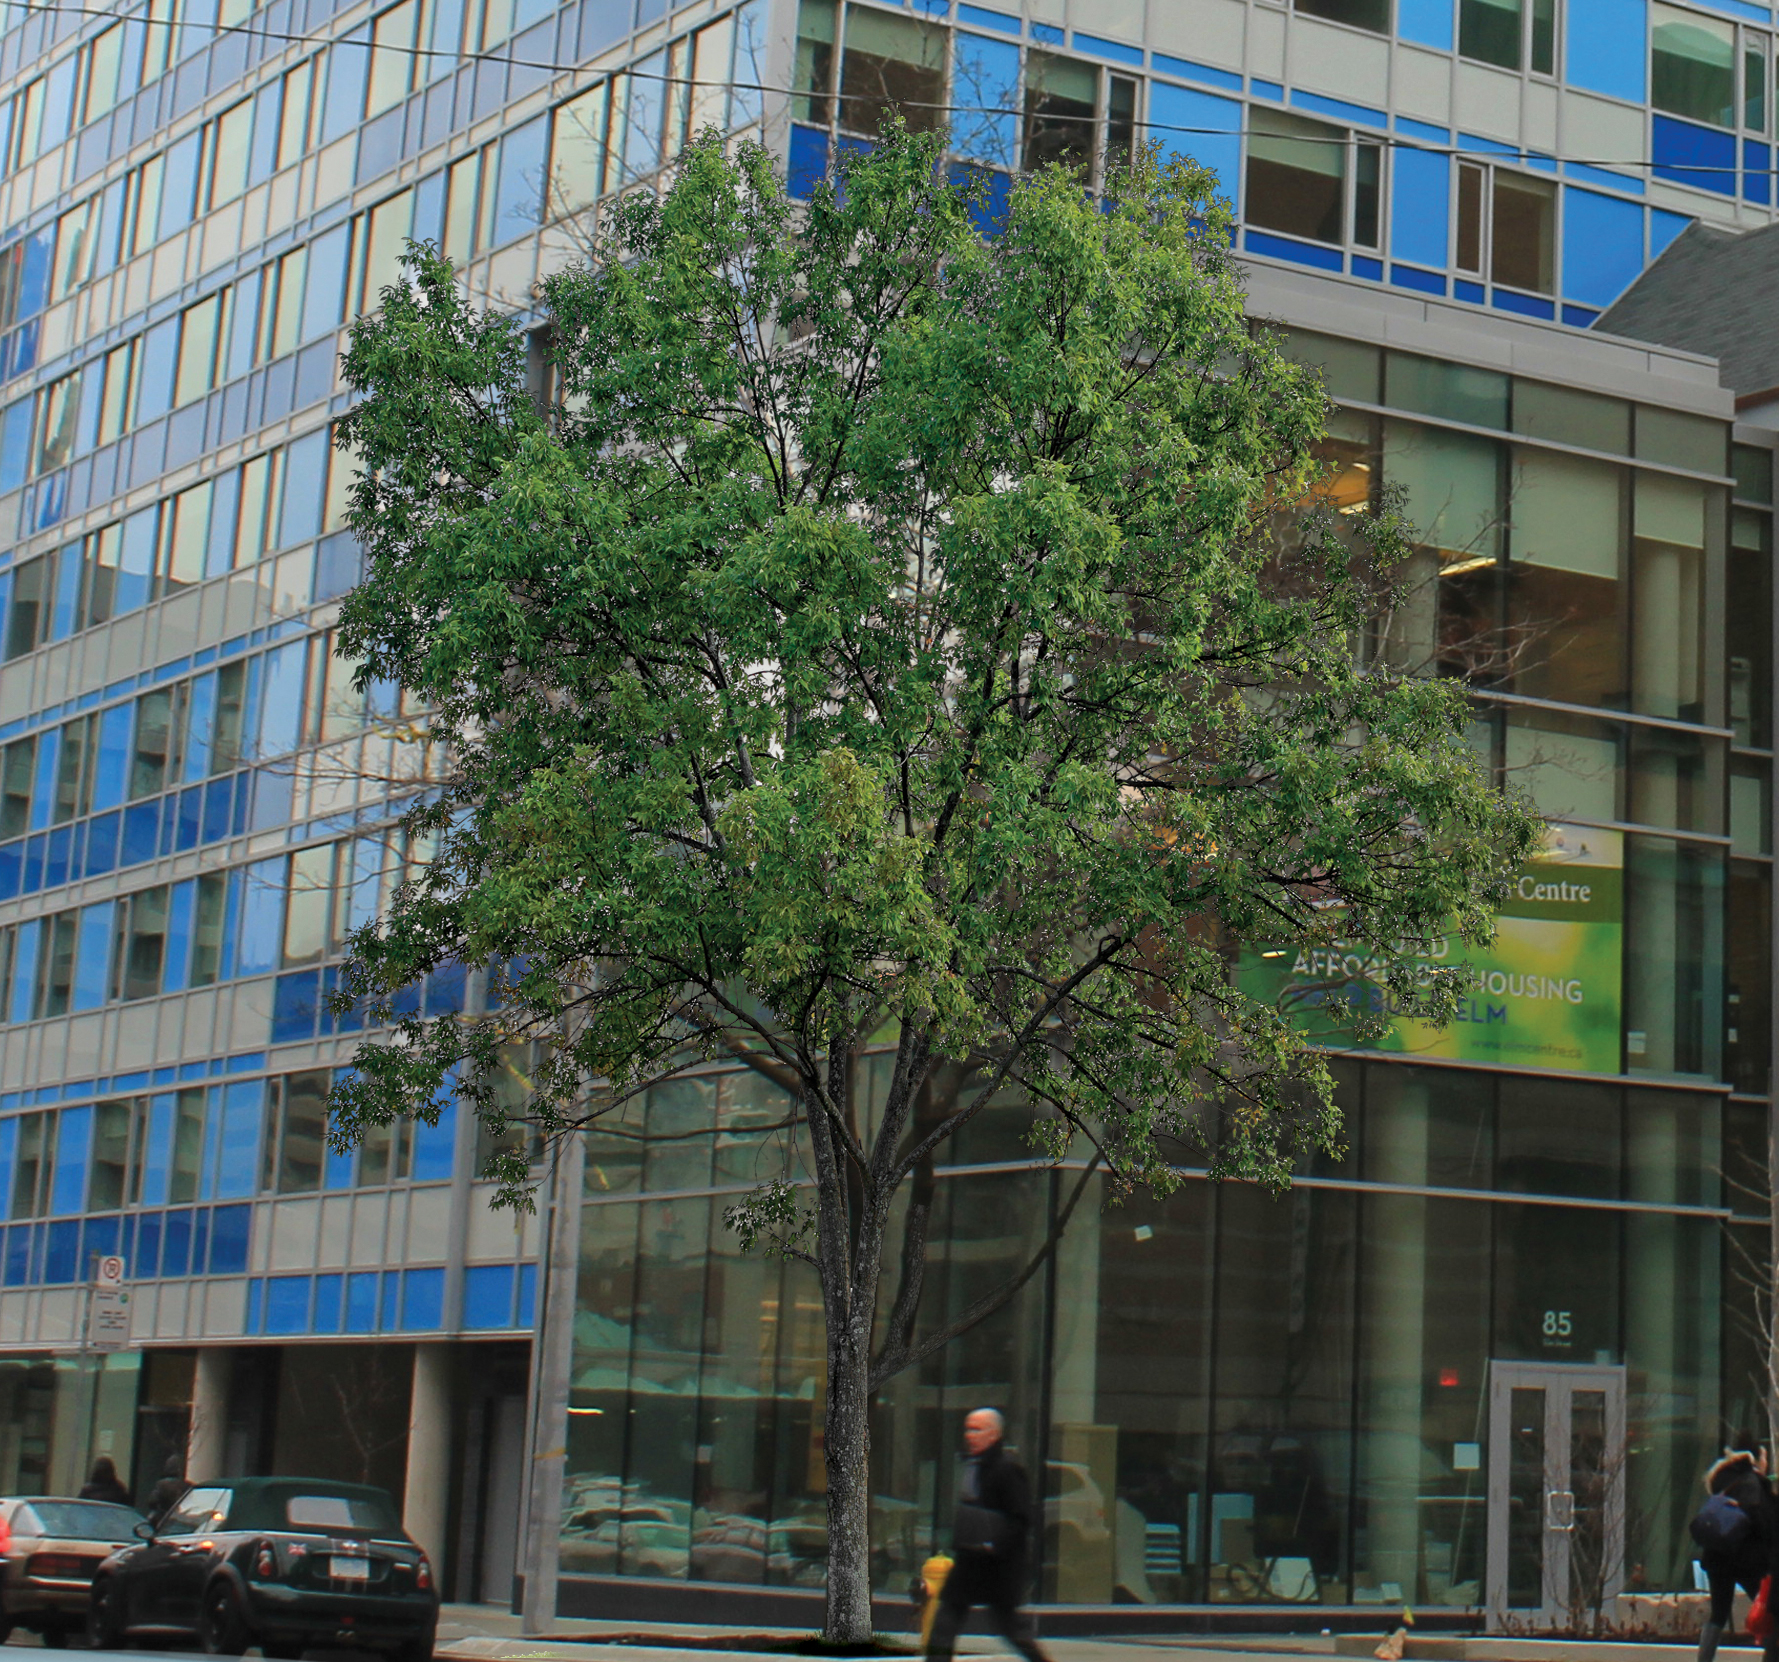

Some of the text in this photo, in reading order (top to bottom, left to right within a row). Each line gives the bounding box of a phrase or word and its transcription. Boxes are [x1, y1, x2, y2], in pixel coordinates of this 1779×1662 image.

[1516, 875, 1592, 904] Centre
[1469, 968, 1583, 1005] HOUSING
[1543, 1310, 1572, 1335] 85
